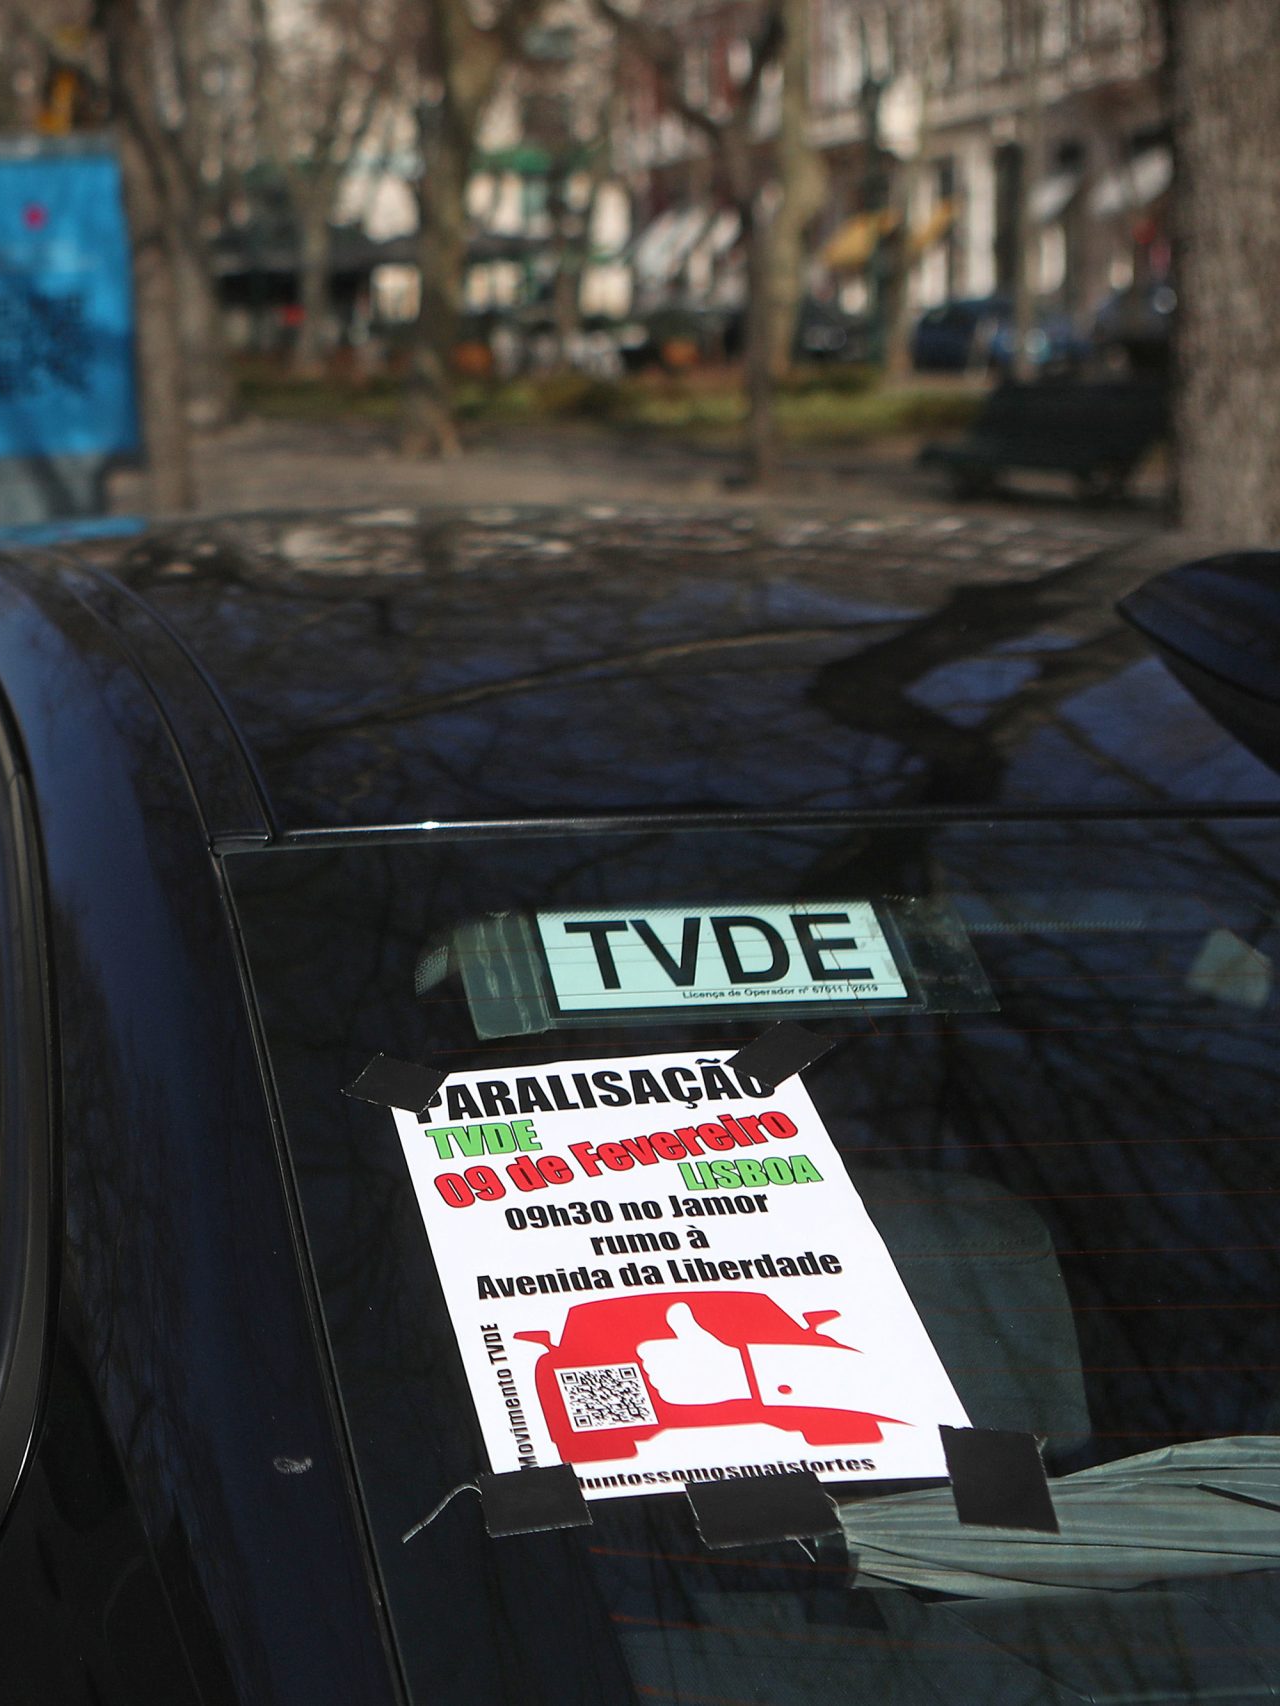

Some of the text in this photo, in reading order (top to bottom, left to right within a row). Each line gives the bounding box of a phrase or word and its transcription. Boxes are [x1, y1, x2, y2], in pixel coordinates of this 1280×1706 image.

[564, 912, 874, 991] TVDE
[682, 990, 725, 999] Licença
[728, 989, 742, 997] de
[744, 987, 795, 997] Operador
[425, 1119, 543, 1160] TVDE
[434, 1111, 799, 1209] 09 de Fevereiro
[677, 1155, 823, 1191] LISBOA
[504, 1192, 770, 1231] 09h30 no Jamor
[589, 1225, 711, 1256] rumo à
[476, 1251, 843, 1300] Avenida da Liberdade
[480, 1323, 508, 1366] TVDE
